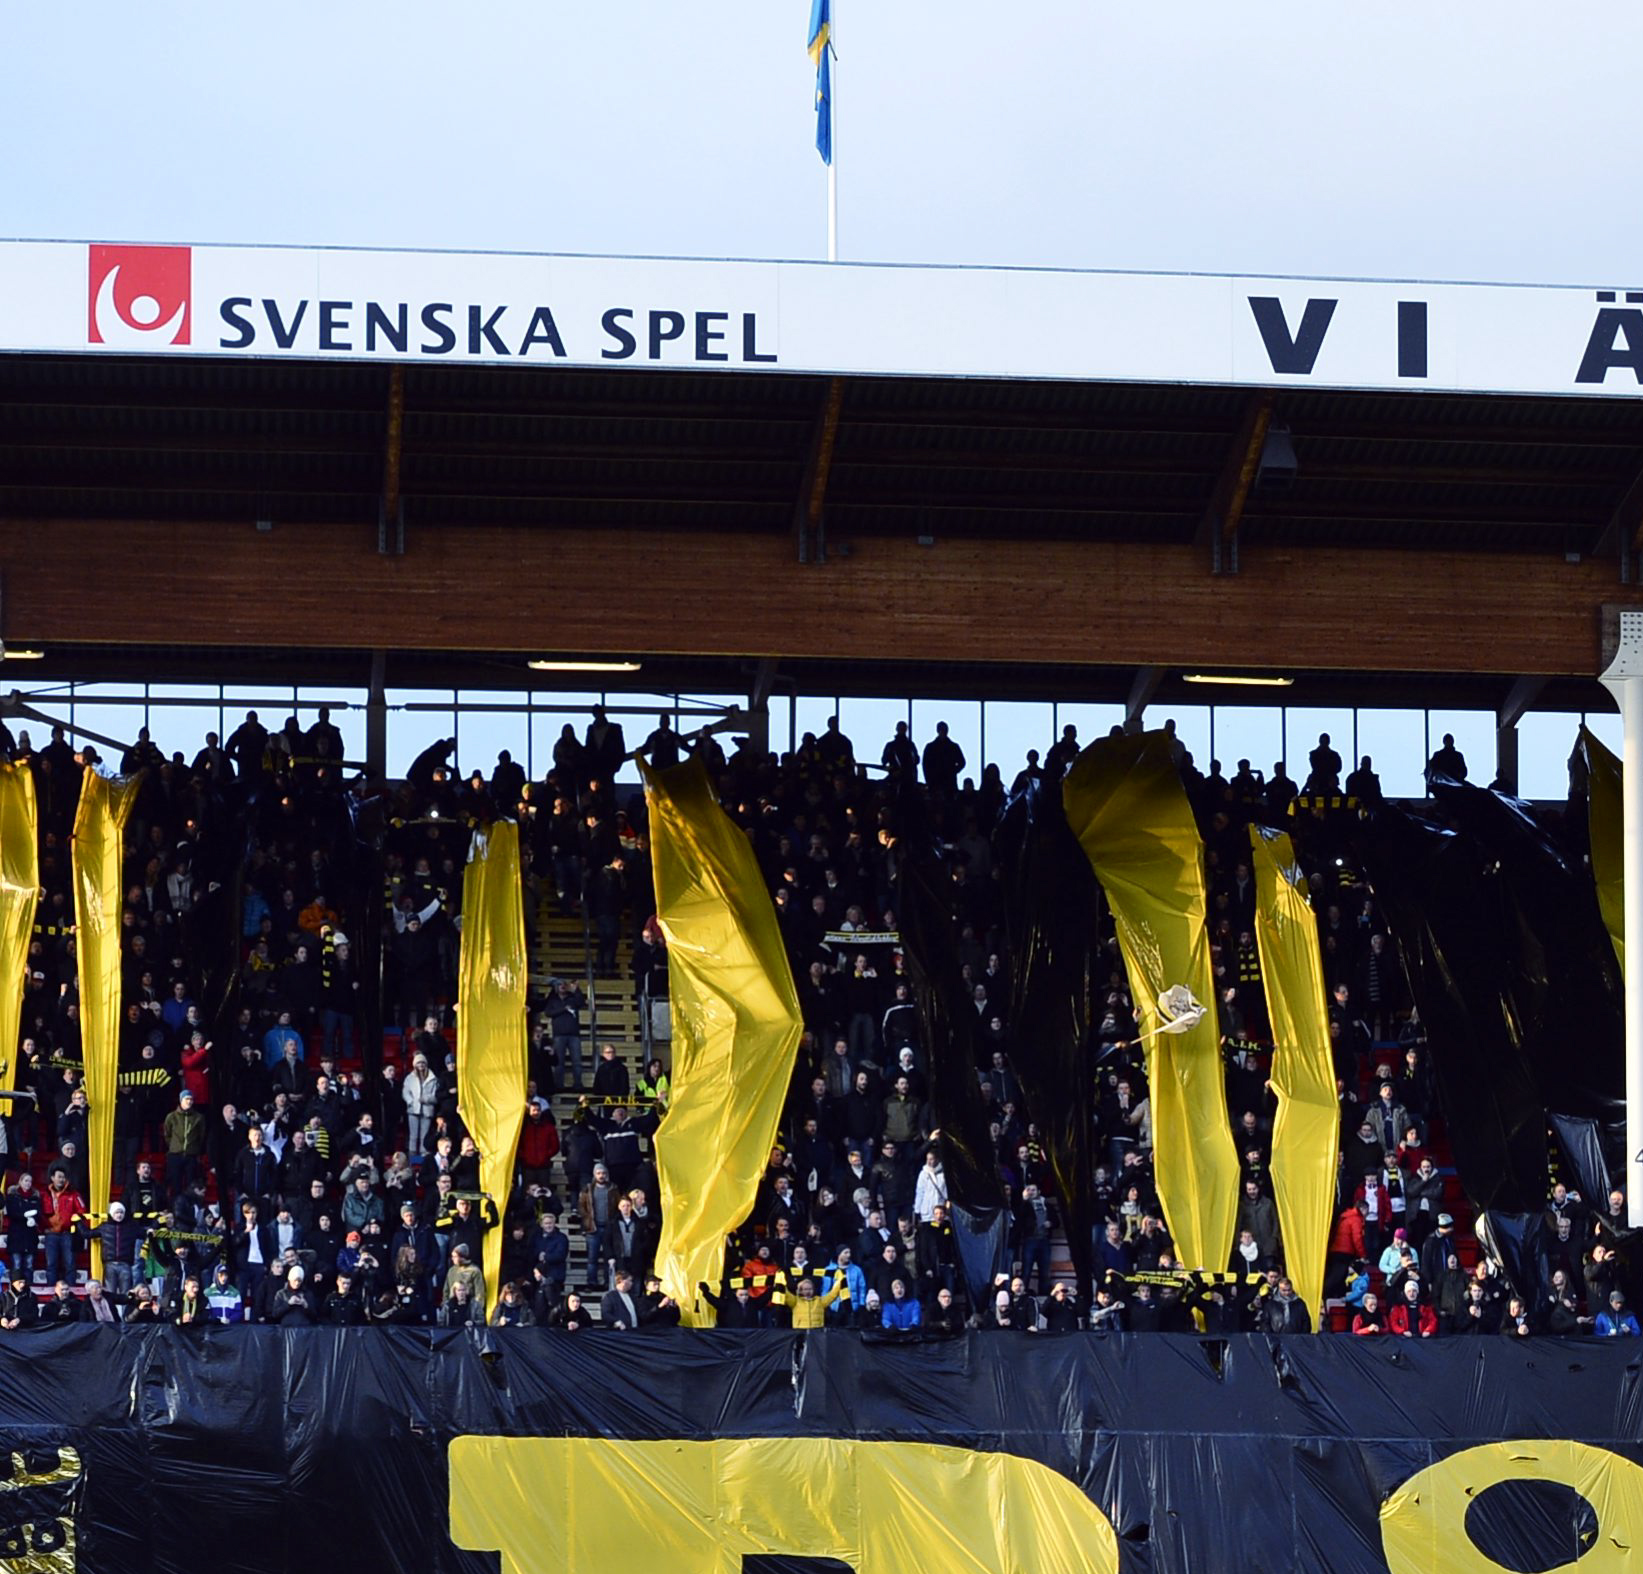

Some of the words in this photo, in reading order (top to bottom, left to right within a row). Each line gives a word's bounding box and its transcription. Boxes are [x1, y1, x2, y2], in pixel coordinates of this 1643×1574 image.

[218, 297, 568, 357] SVENSKA
[600, 307, 779, 363] SPEL
[1247, 296, 1429, 378] VI
